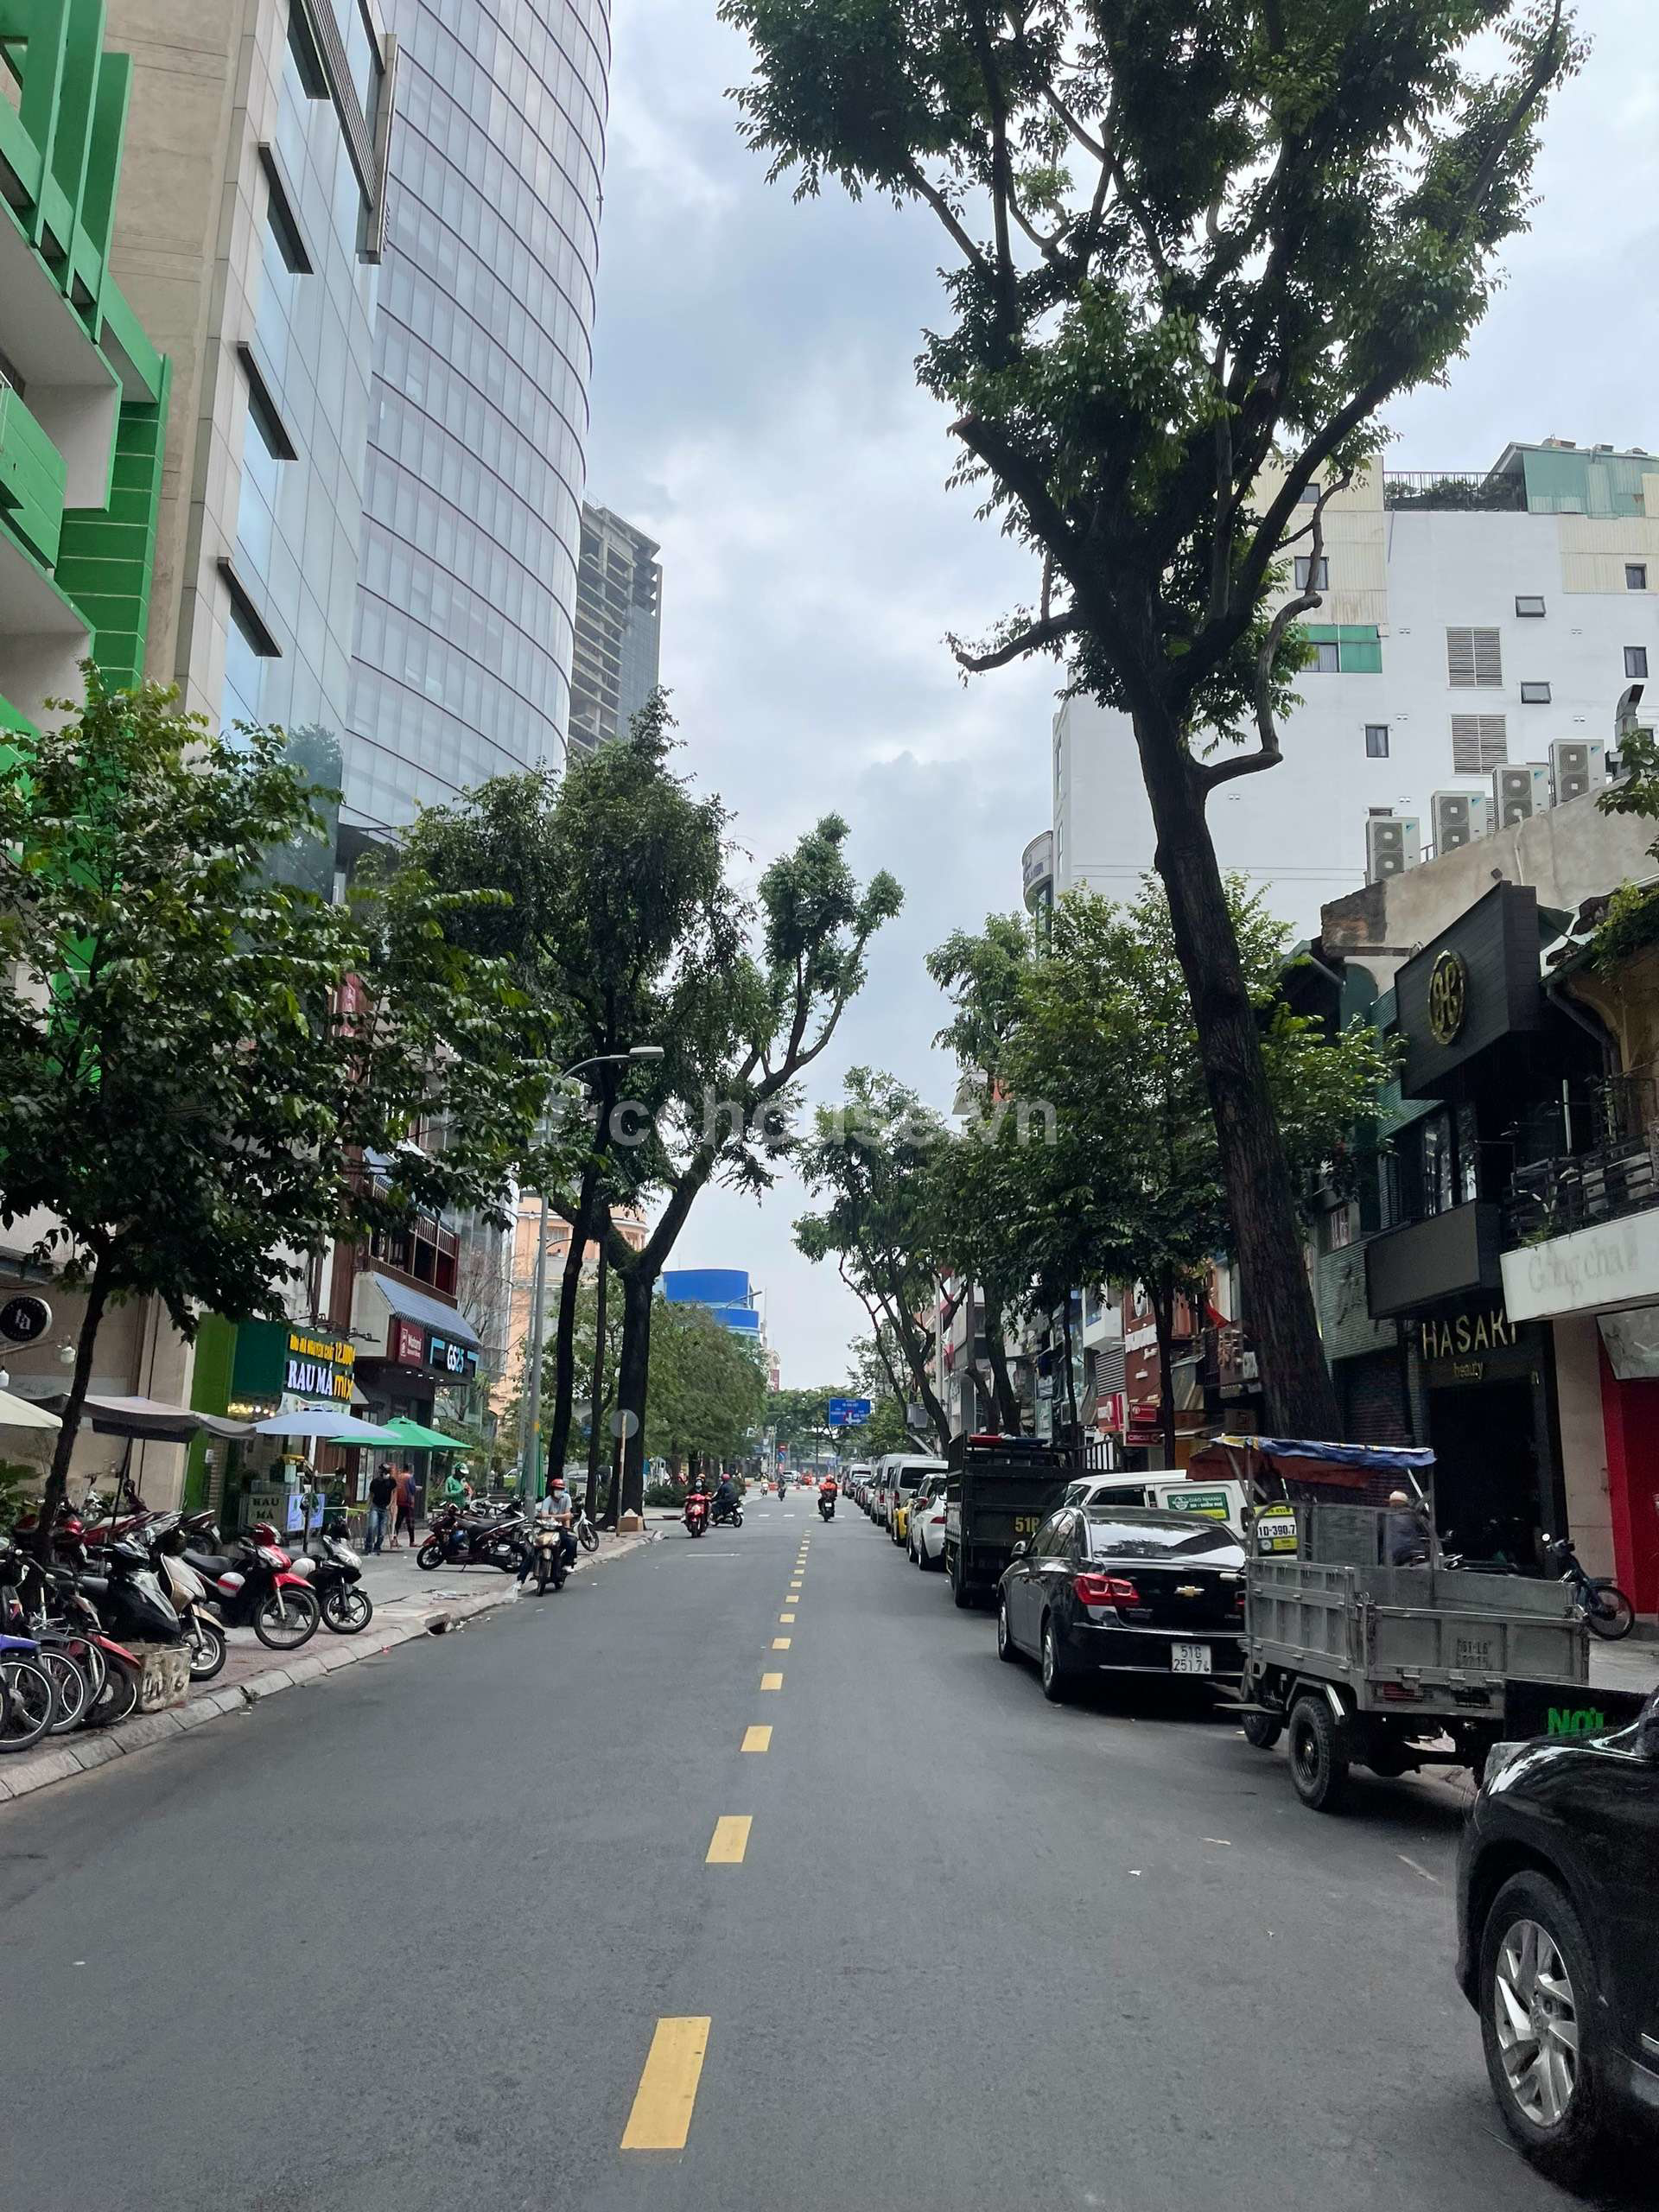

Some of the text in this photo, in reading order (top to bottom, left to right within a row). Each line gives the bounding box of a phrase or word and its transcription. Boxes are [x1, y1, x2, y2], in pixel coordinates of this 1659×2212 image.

[1422, 1307, 1516, 1360] HASAKI
[447, 1344, 465, 1374] GS25
[288, 1360, 355, 1401] RAU MÁ mix
